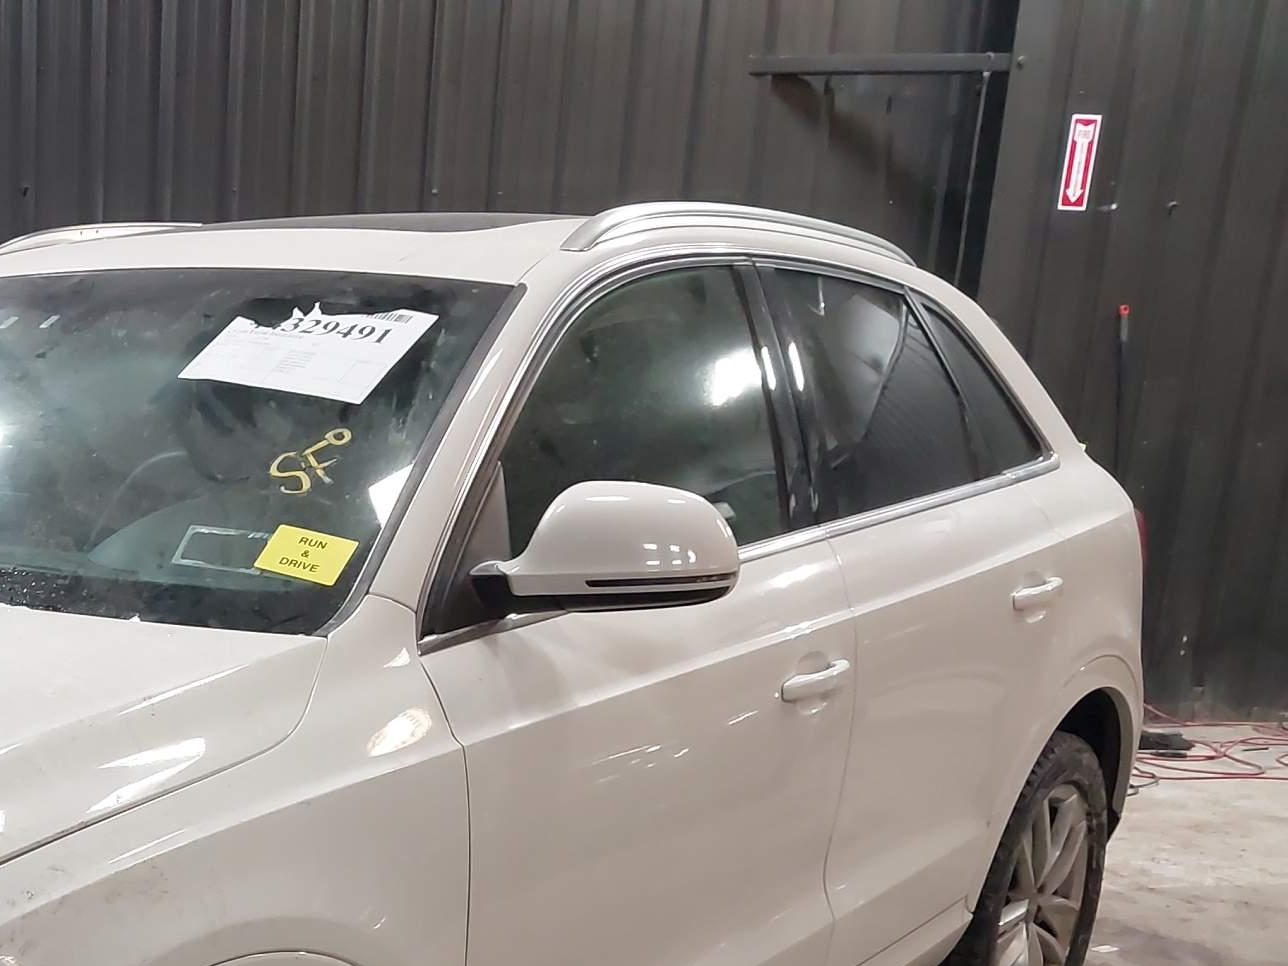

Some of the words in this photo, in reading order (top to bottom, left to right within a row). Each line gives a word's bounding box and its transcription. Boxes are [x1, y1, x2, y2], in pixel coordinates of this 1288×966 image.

[298, 536, 328, 549] RUN
[301, 549, 310, 558] &
[278, 556, 320, 573] DRIVE
